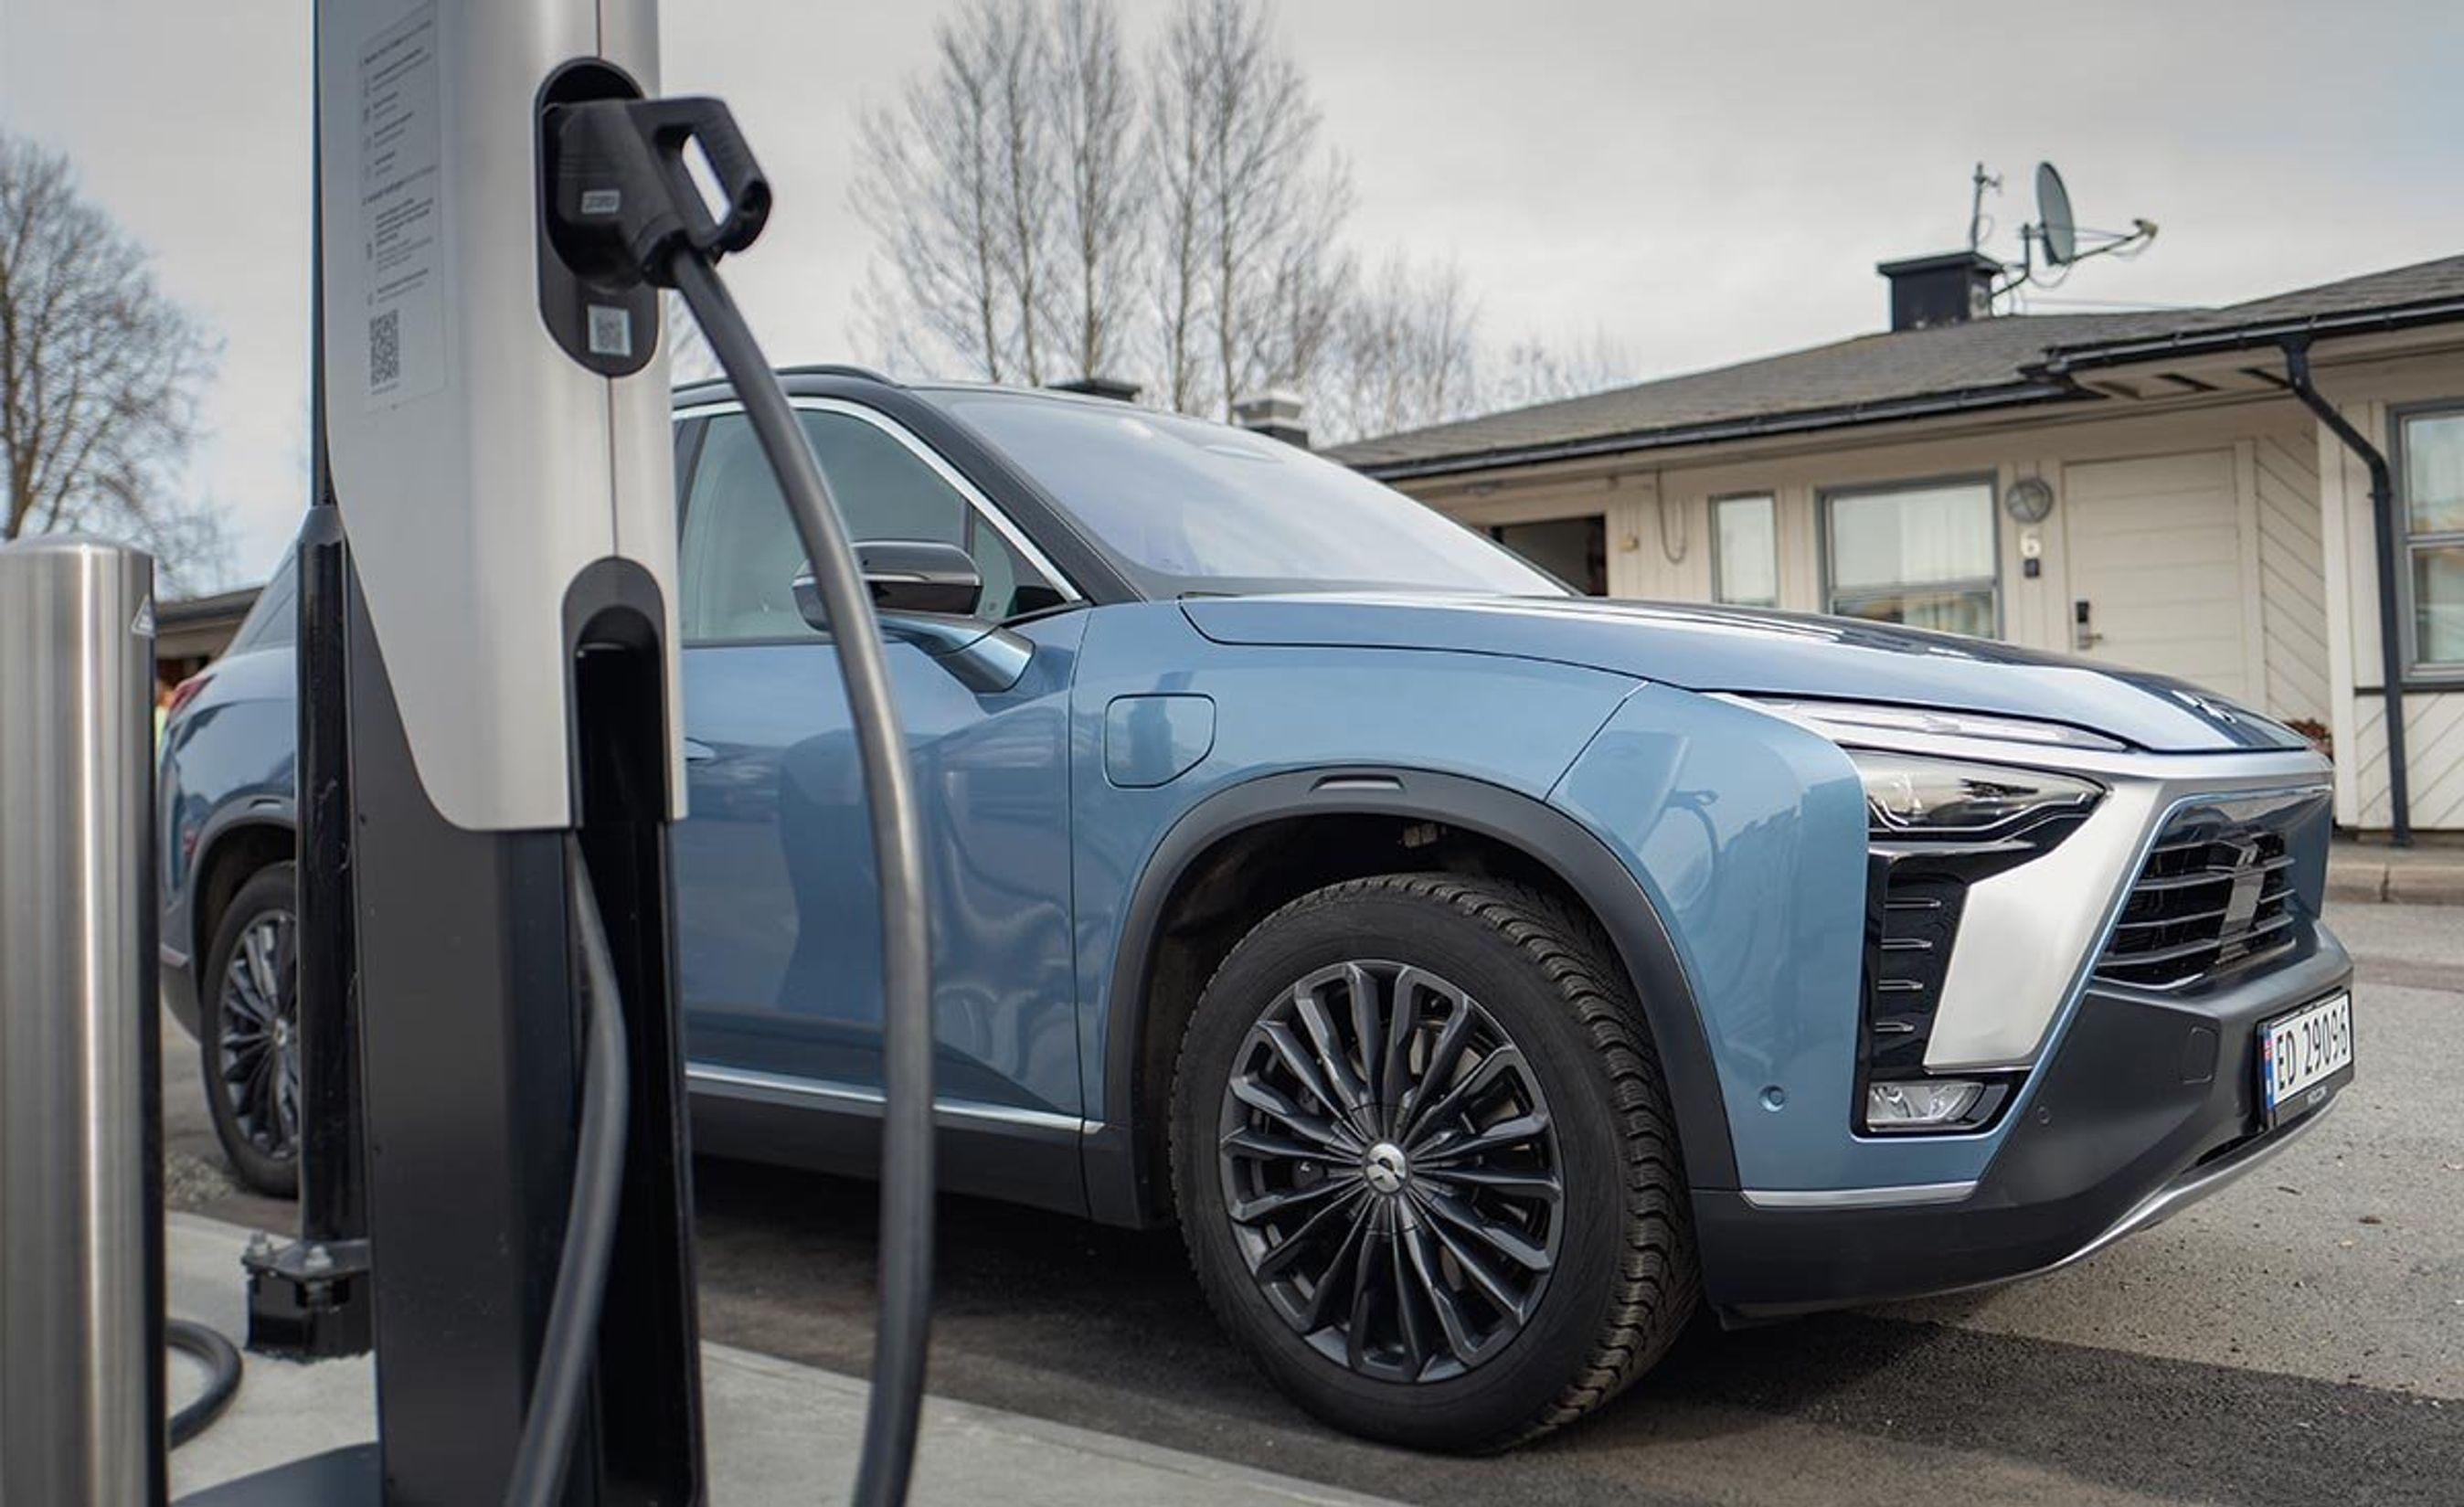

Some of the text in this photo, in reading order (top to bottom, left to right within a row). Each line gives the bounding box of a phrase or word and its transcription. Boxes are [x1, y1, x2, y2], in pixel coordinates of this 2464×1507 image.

[2020, 529, 2042, 557] 6
[2277, 1004, 2348, 1090] ED 29096
